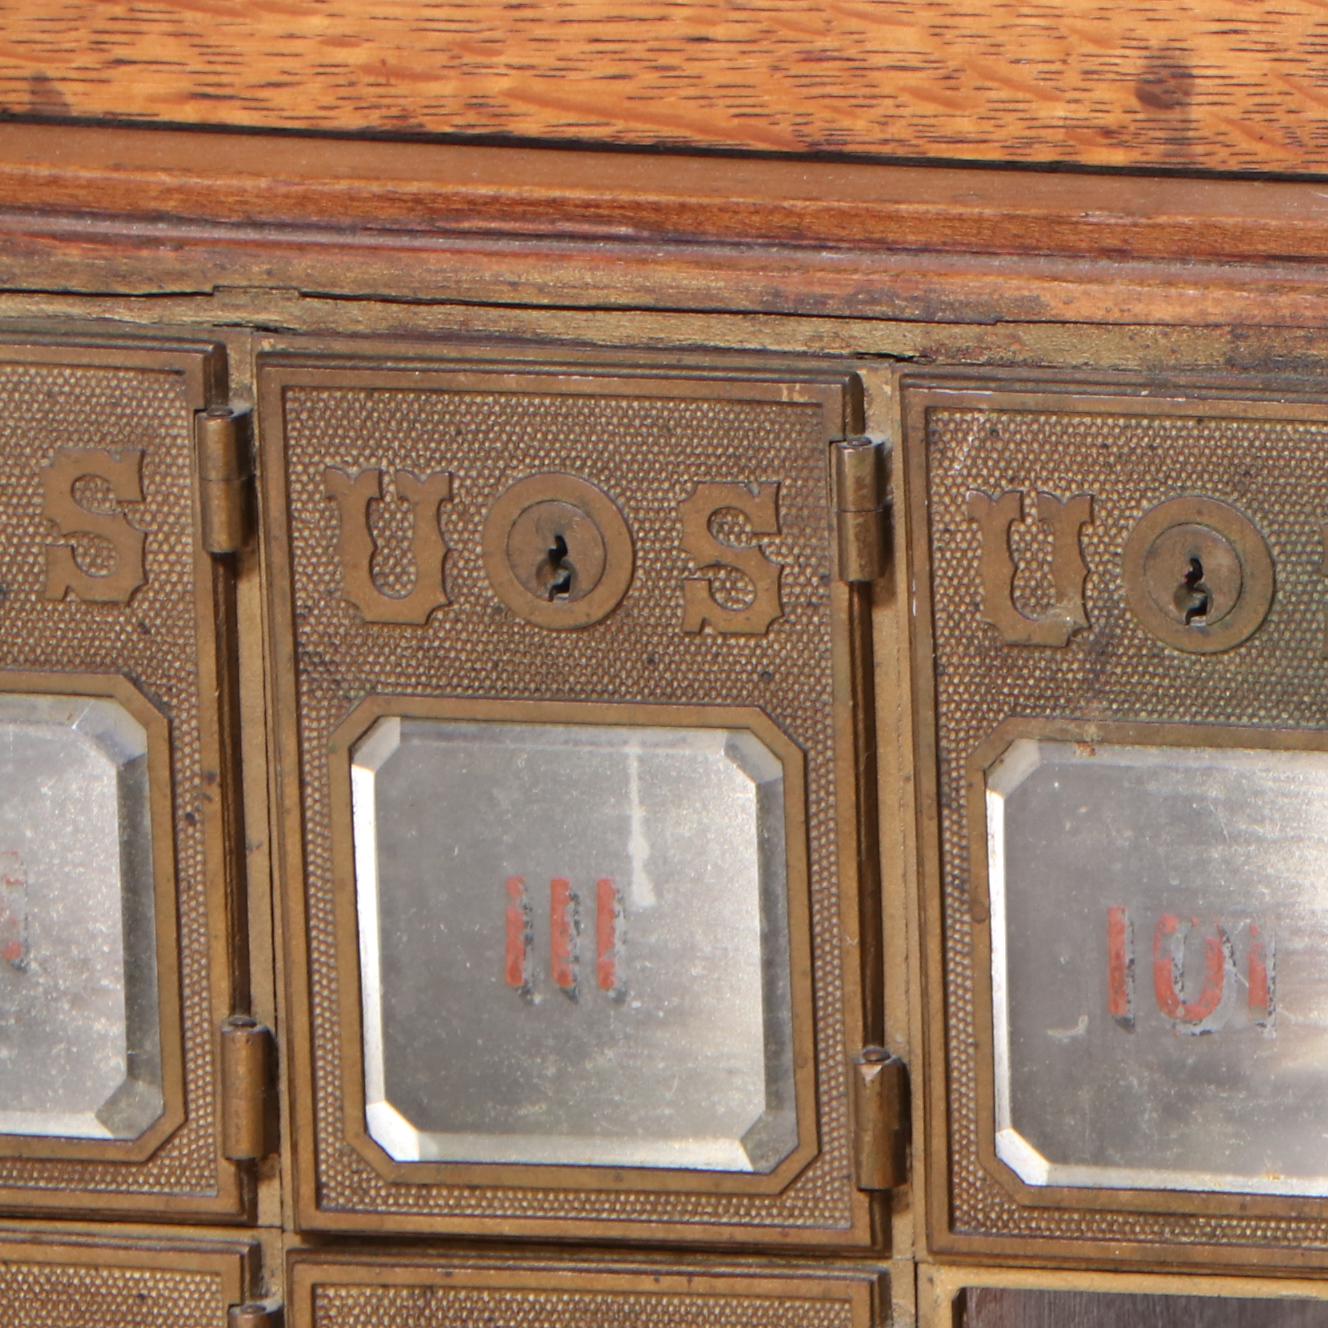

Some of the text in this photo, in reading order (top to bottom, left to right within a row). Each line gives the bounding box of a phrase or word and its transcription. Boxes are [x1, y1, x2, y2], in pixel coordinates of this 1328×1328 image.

[41, 447, 148, 602] S
[325, 467, 785, 637] U S
[965, 490, 1095, 648] U
[504, 874, 628, 1003] 111
[1107, 905, 1276, 1039] 101
